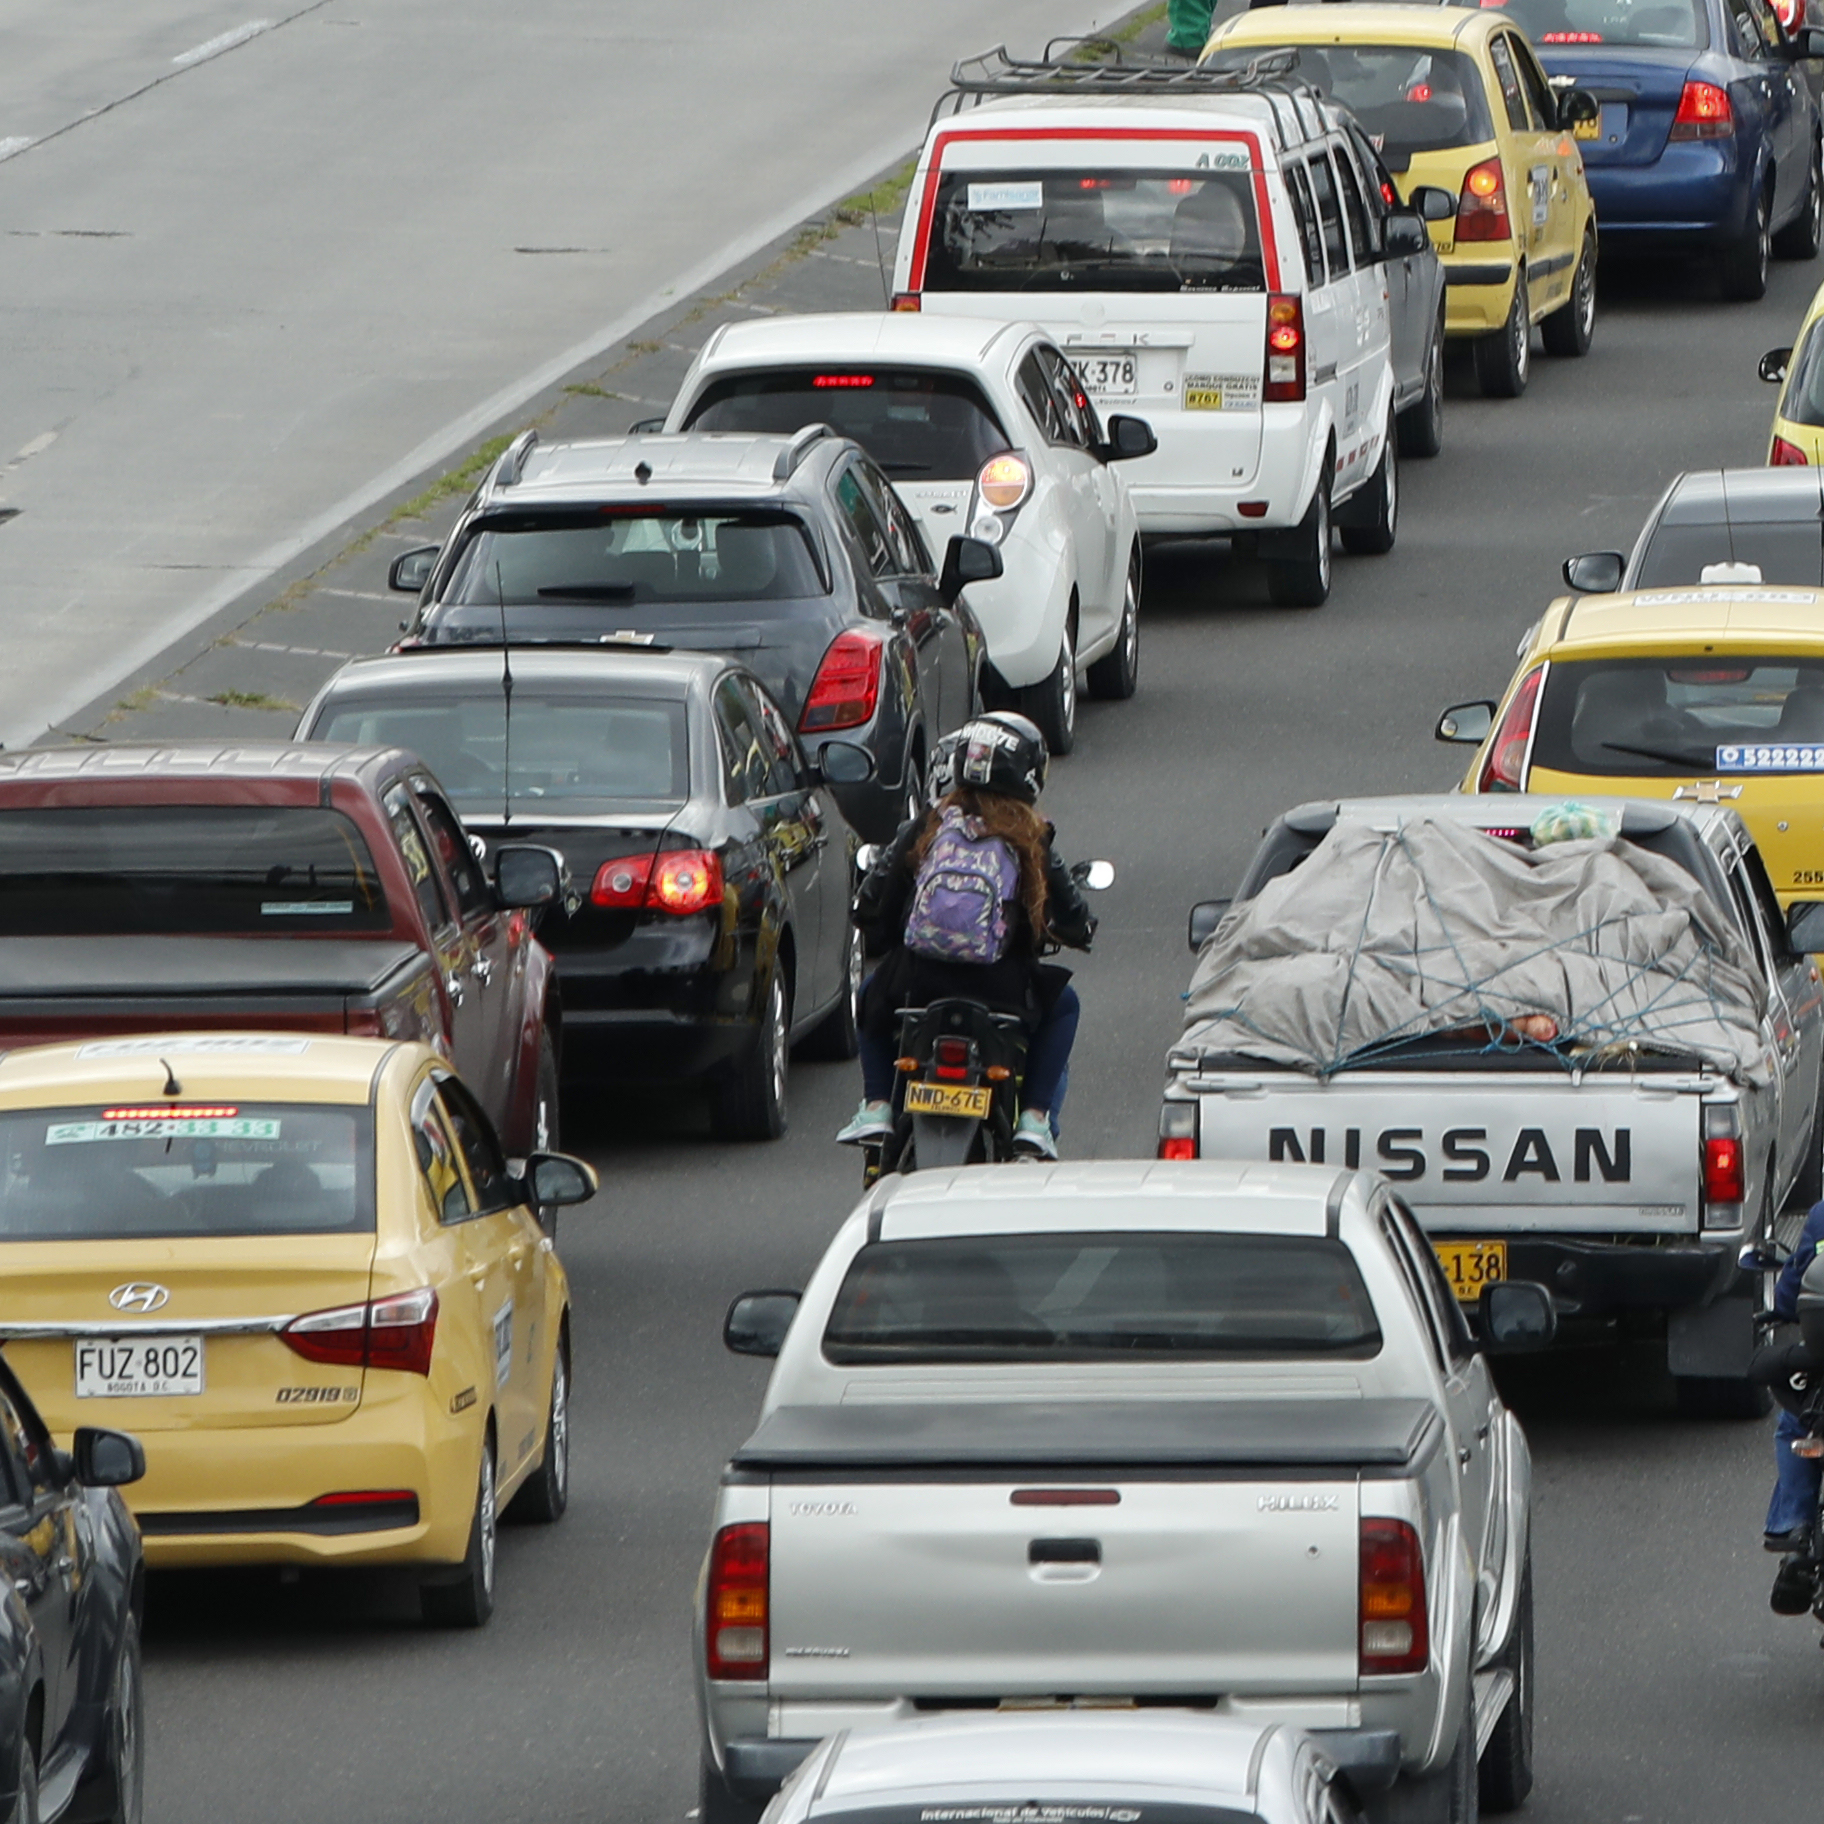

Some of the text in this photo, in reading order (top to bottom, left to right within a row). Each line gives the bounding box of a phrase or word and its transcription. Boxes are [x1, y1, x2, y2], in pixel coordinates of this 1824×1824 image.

[1269, 1126, 1633, 1183] NISSAN
[275, 1387, 342, 1404] 02919
[790, 1501, 859, 1518] TOYOTA
[1257, 1494, 1341, 1512] HILUX
